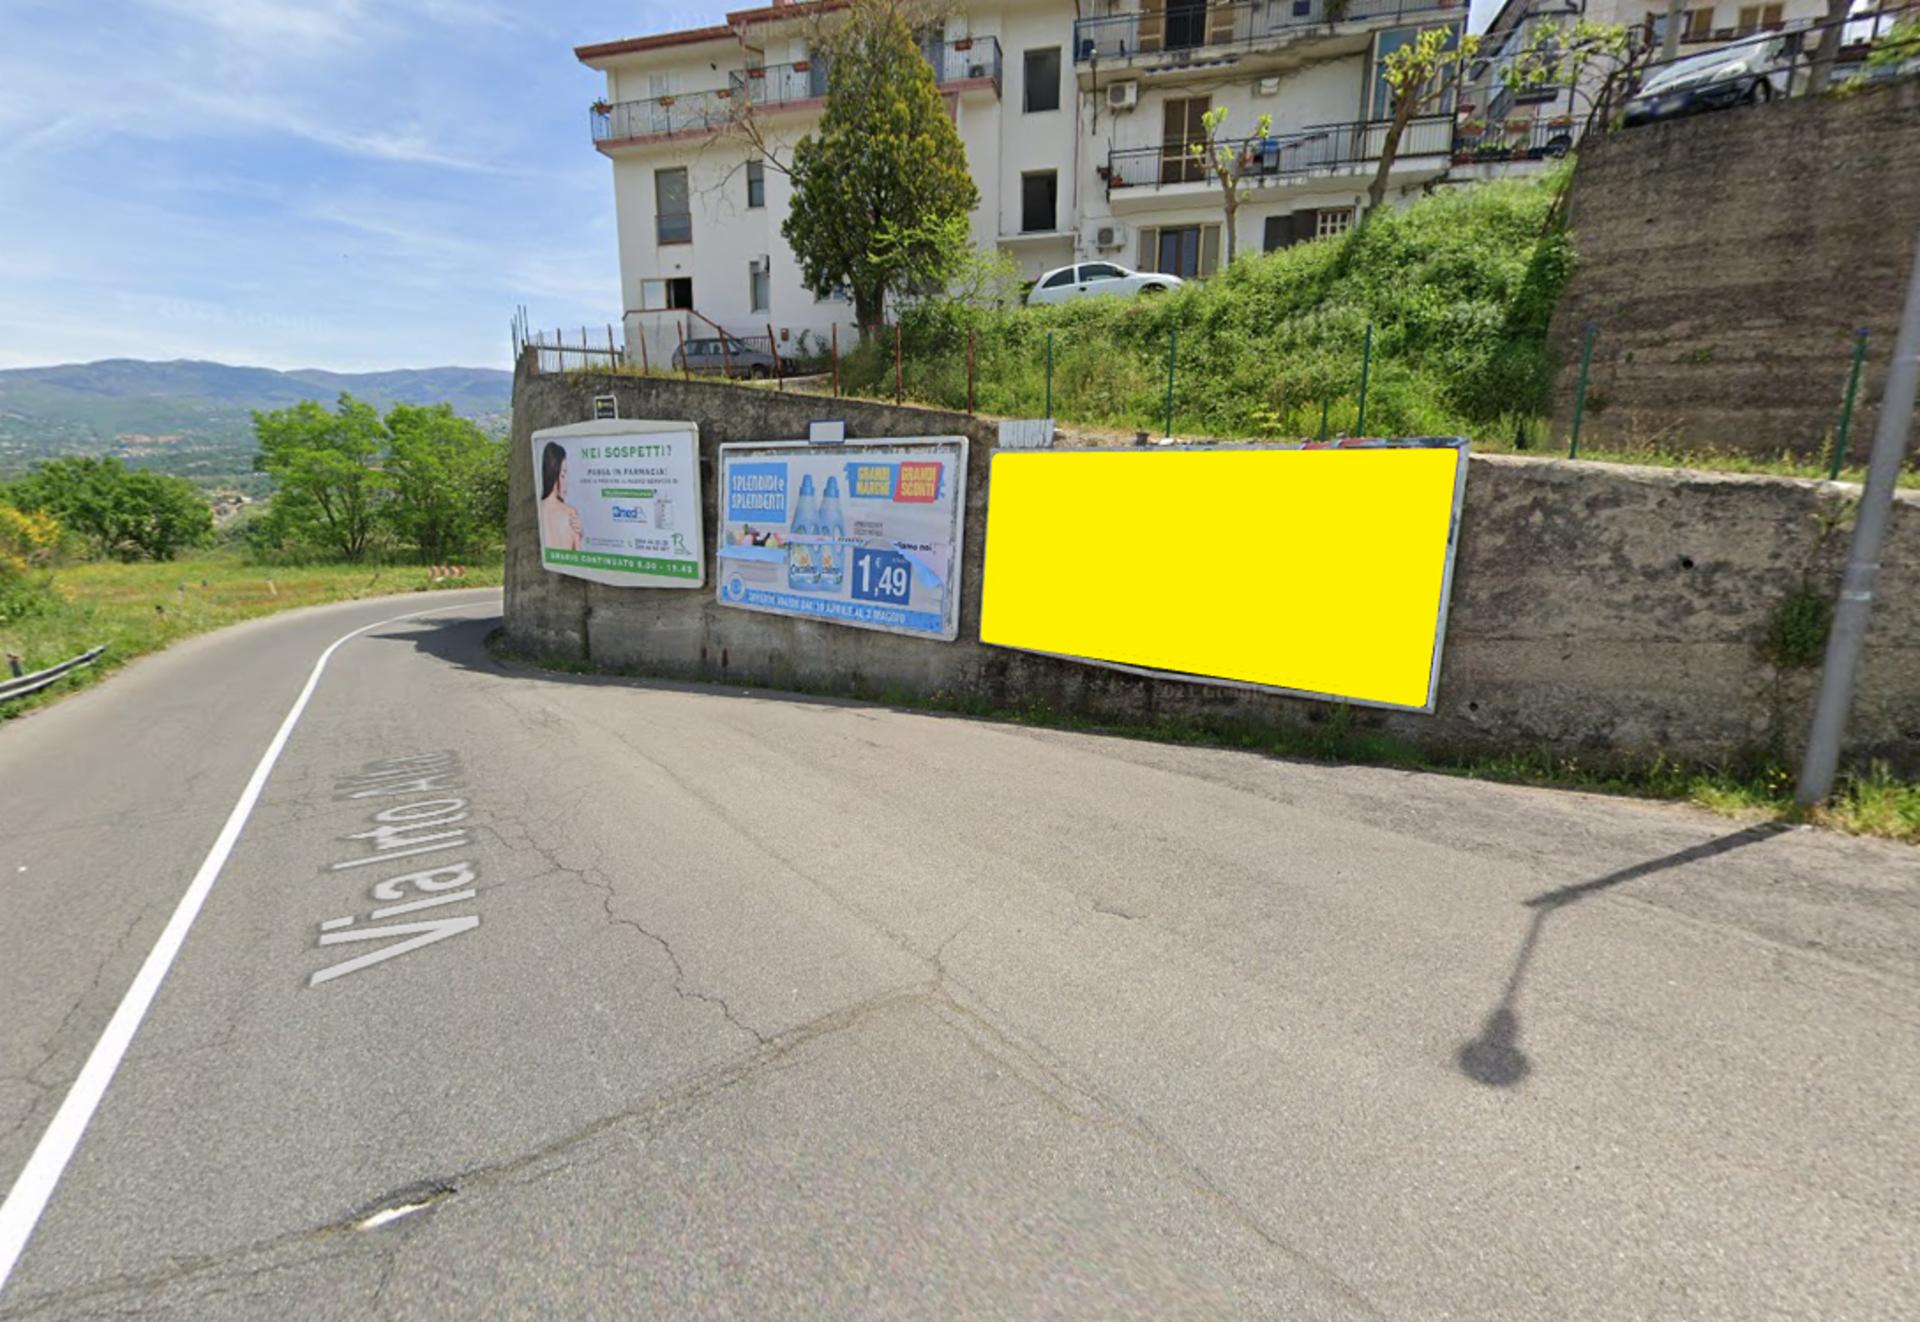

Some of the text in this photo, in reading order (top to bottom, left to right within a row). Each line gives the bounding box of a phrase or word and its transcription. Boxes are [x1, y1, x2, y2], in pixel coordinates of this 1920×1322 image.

[581, 444, 672, 459] NEI SOSPETTI?
[901, 466, 936, 480] GRANDI
[732, 474, 777, 491] SPLENDIDI
[856, 481, 890, 496] MARCHE
[901, 482, 934, 497] SCONTI
[731, 493, 785, 510] SPLENDENTI
[582, 555, 634, 568] CONTINUATO
